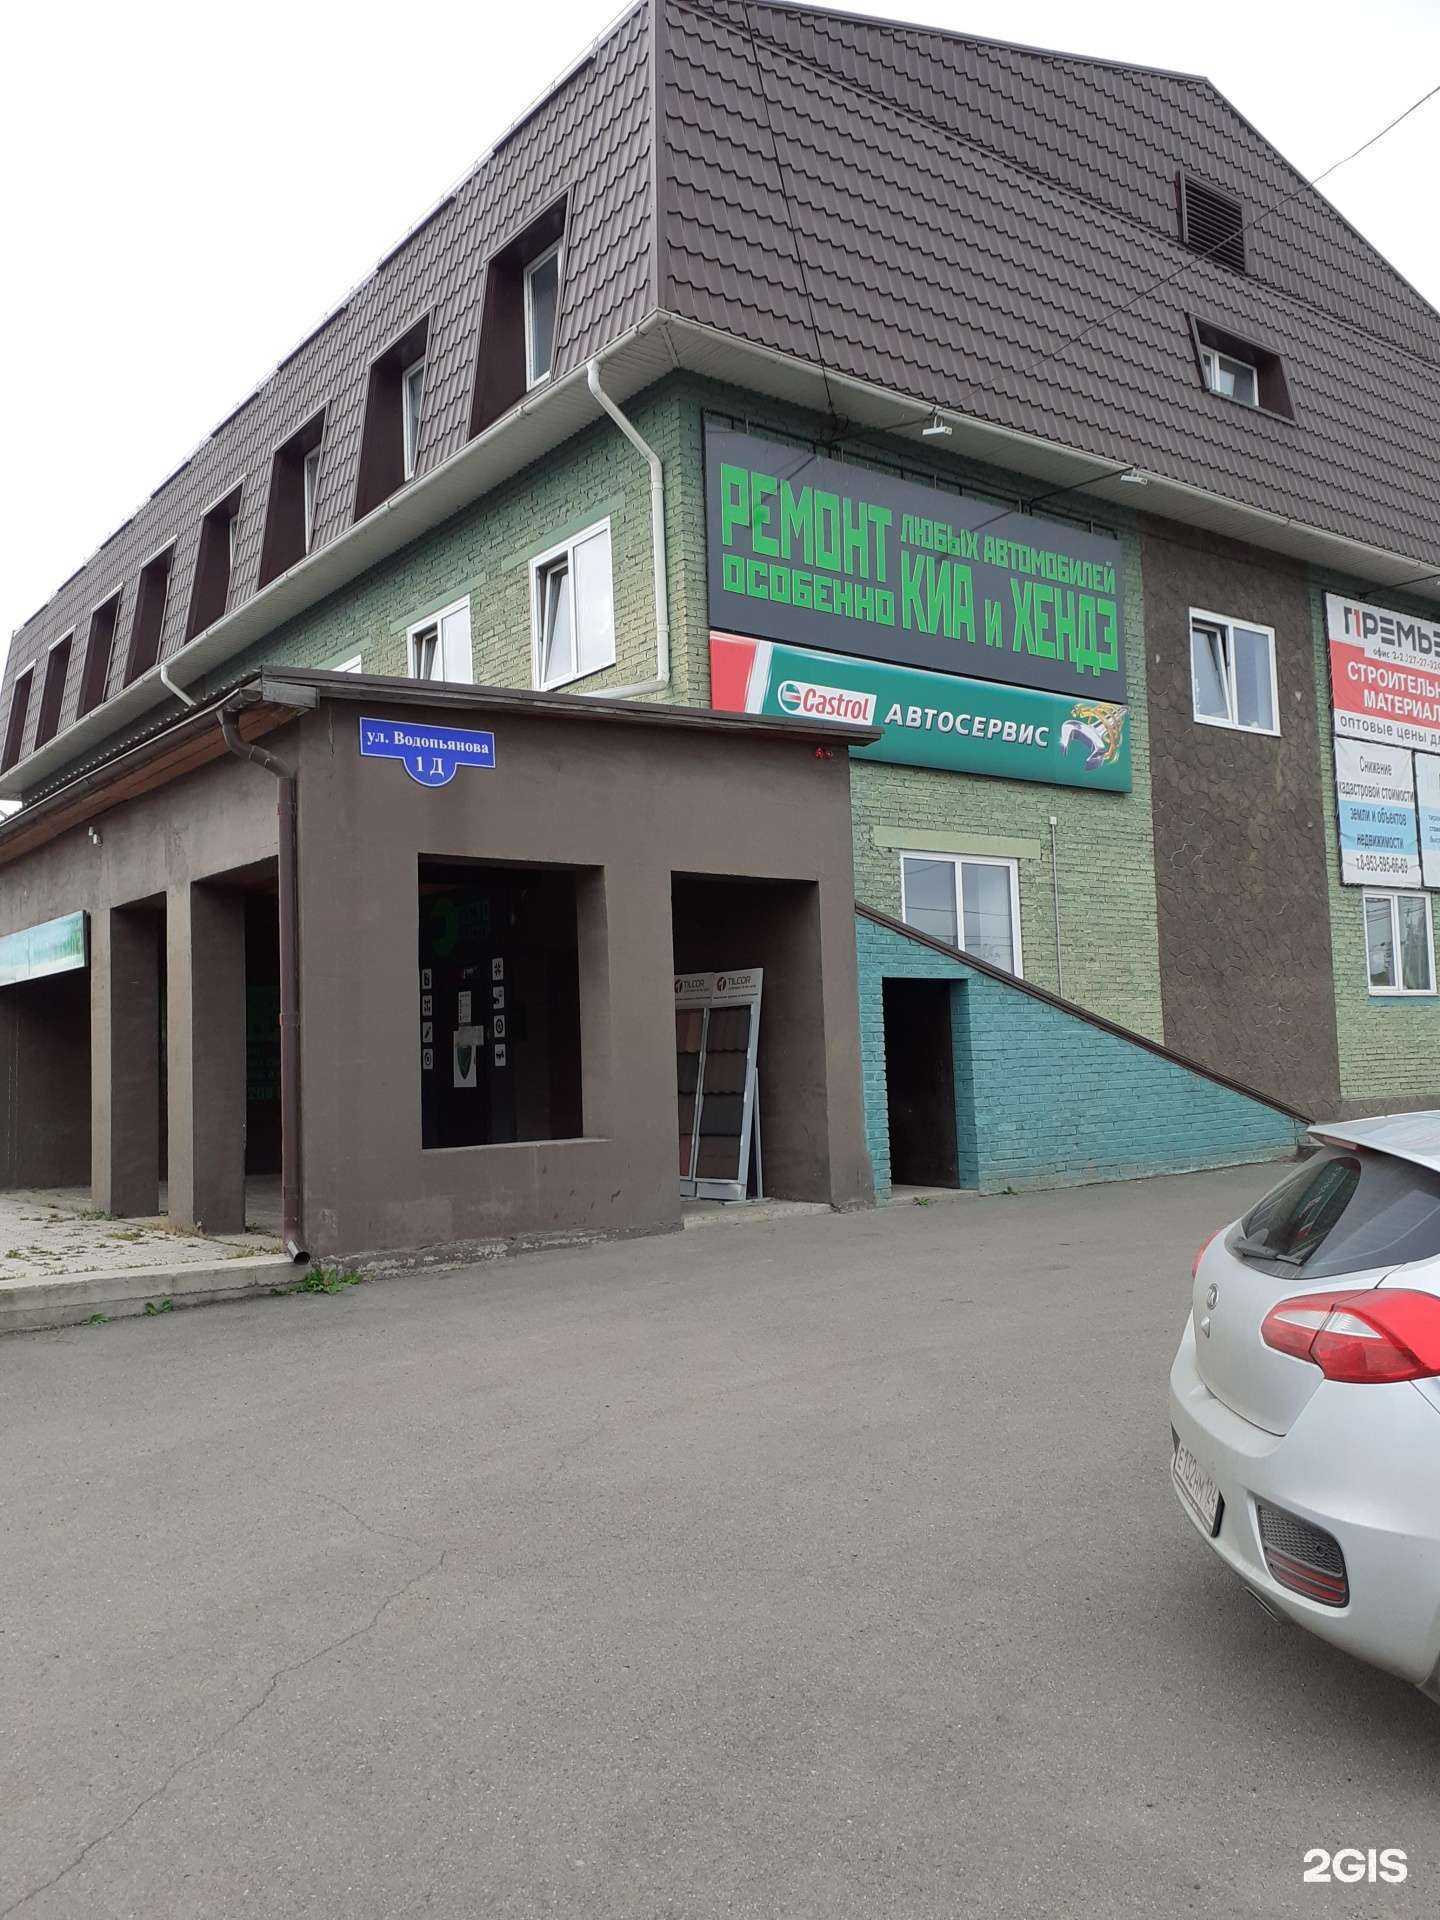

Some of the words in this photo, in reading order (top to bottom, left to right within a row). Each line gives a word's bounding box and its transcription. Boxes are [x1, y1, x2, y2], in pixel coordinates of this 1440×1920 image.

[721, 462, 892, 583] РЕМОНТ
[900, 513, 981, 560] ЛЮБЫХ
[984, 534, 1116, 595] АВТОМОБИЛЕЙ
[722, 553, 896, 626] ОСОБЕННО
[901, 550, 976, 643] КИА
[1010, 577, 1119, 676] ХЕНДЭ
[802, 686, 870, 721] Castrol
[884, 703, 1050, 748] АВТОСЕРВИС
[1340, 715, 1393, 736] оптовые
[1396, 725, 1427, 743] цены
[366, 731, 389, 745] ул.
[394, 731, 489, 754] Водопьянова
[416, 756, 424, 772] 1
[429, 757, 445, 777] Д
[1359, 756, 1392, 776] Снижение
[1381, 787, 1414, 803] стоимости
[1350, 808, 1370, 822] земли
[1377, 807, 1407, 826] объектов
[1356, 833, 1405, 849] недвижимости
[683, 979, 705, 989] TILCOR
[727, 976, 752, 986] TILCOR
